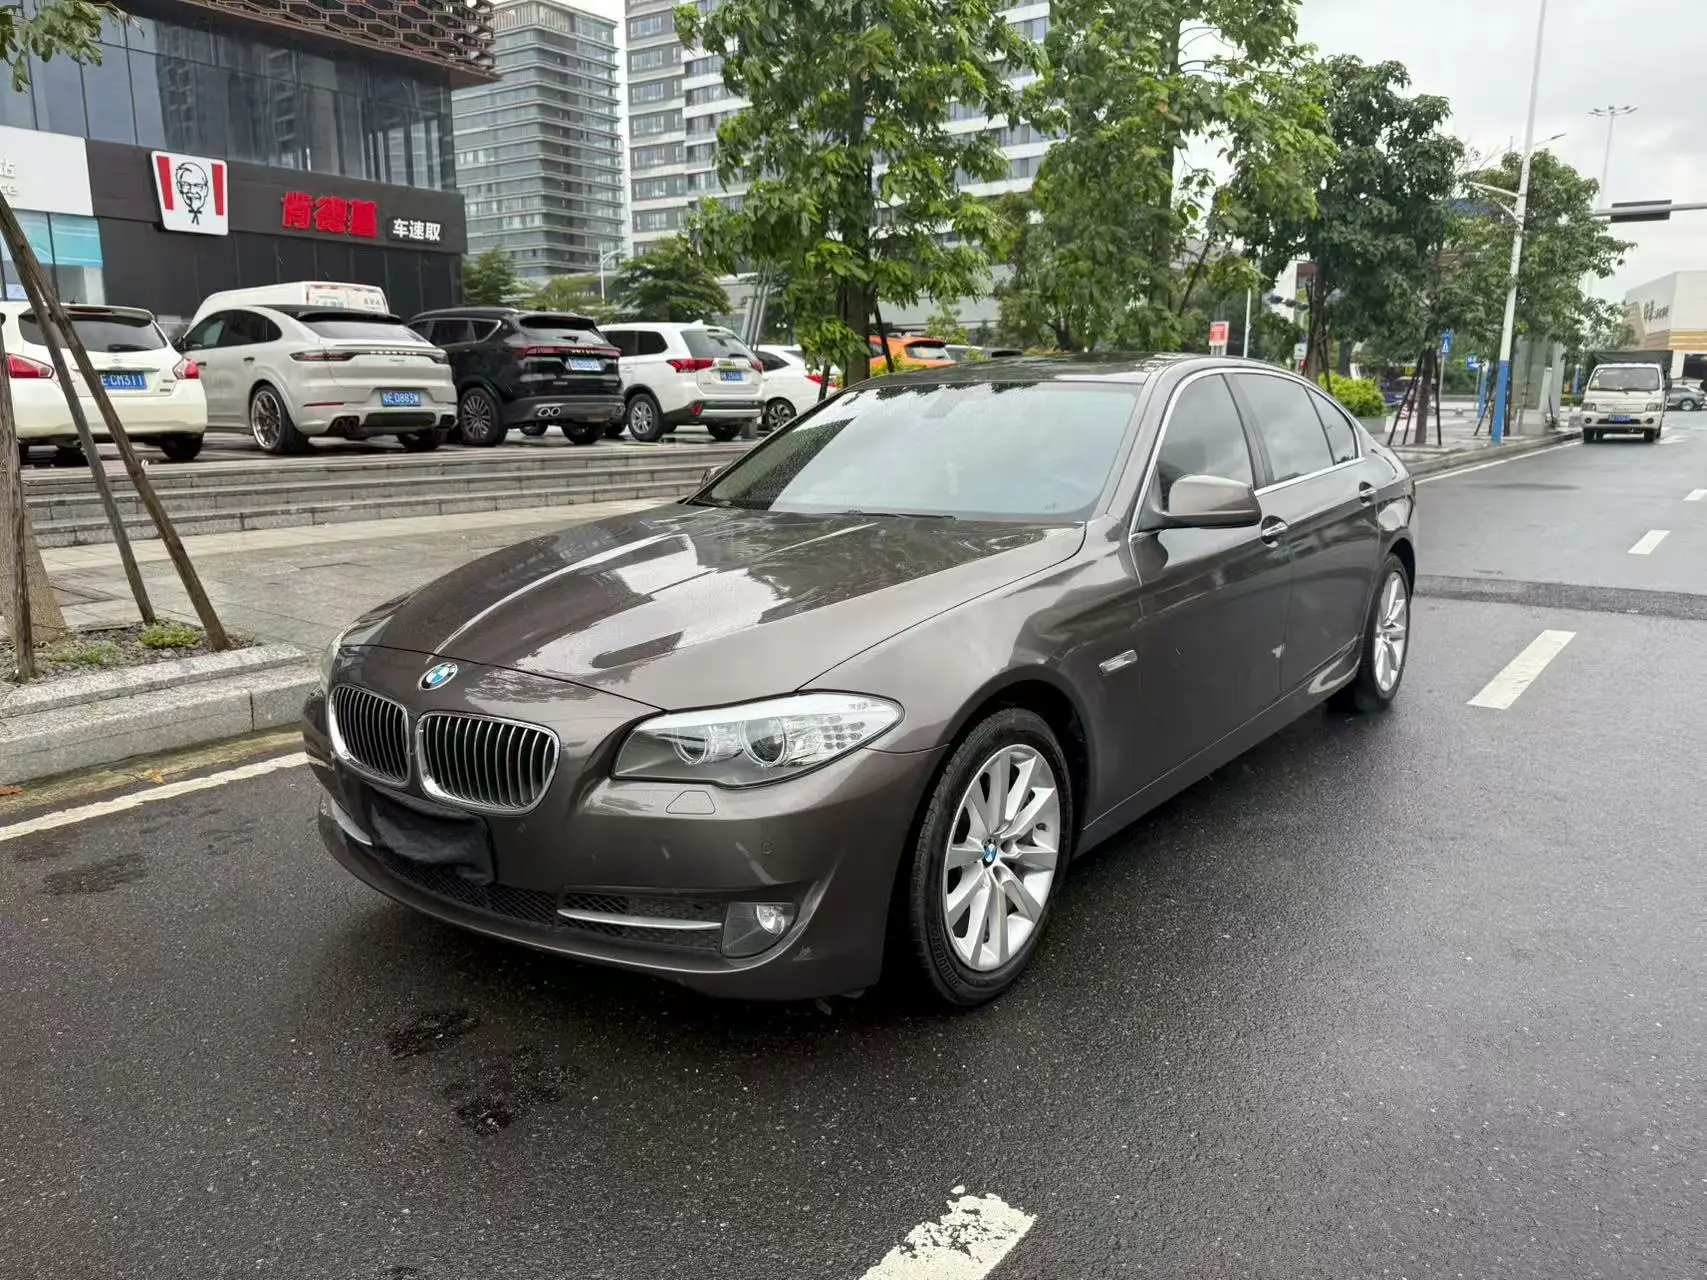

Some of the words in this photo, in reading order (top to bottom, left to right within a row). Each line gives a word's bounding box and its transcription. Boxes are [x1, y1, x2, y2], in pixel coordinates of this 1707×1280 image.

[281, 191, 378, 237] 肯德基
[393, 218, 441, 241] 车速取
